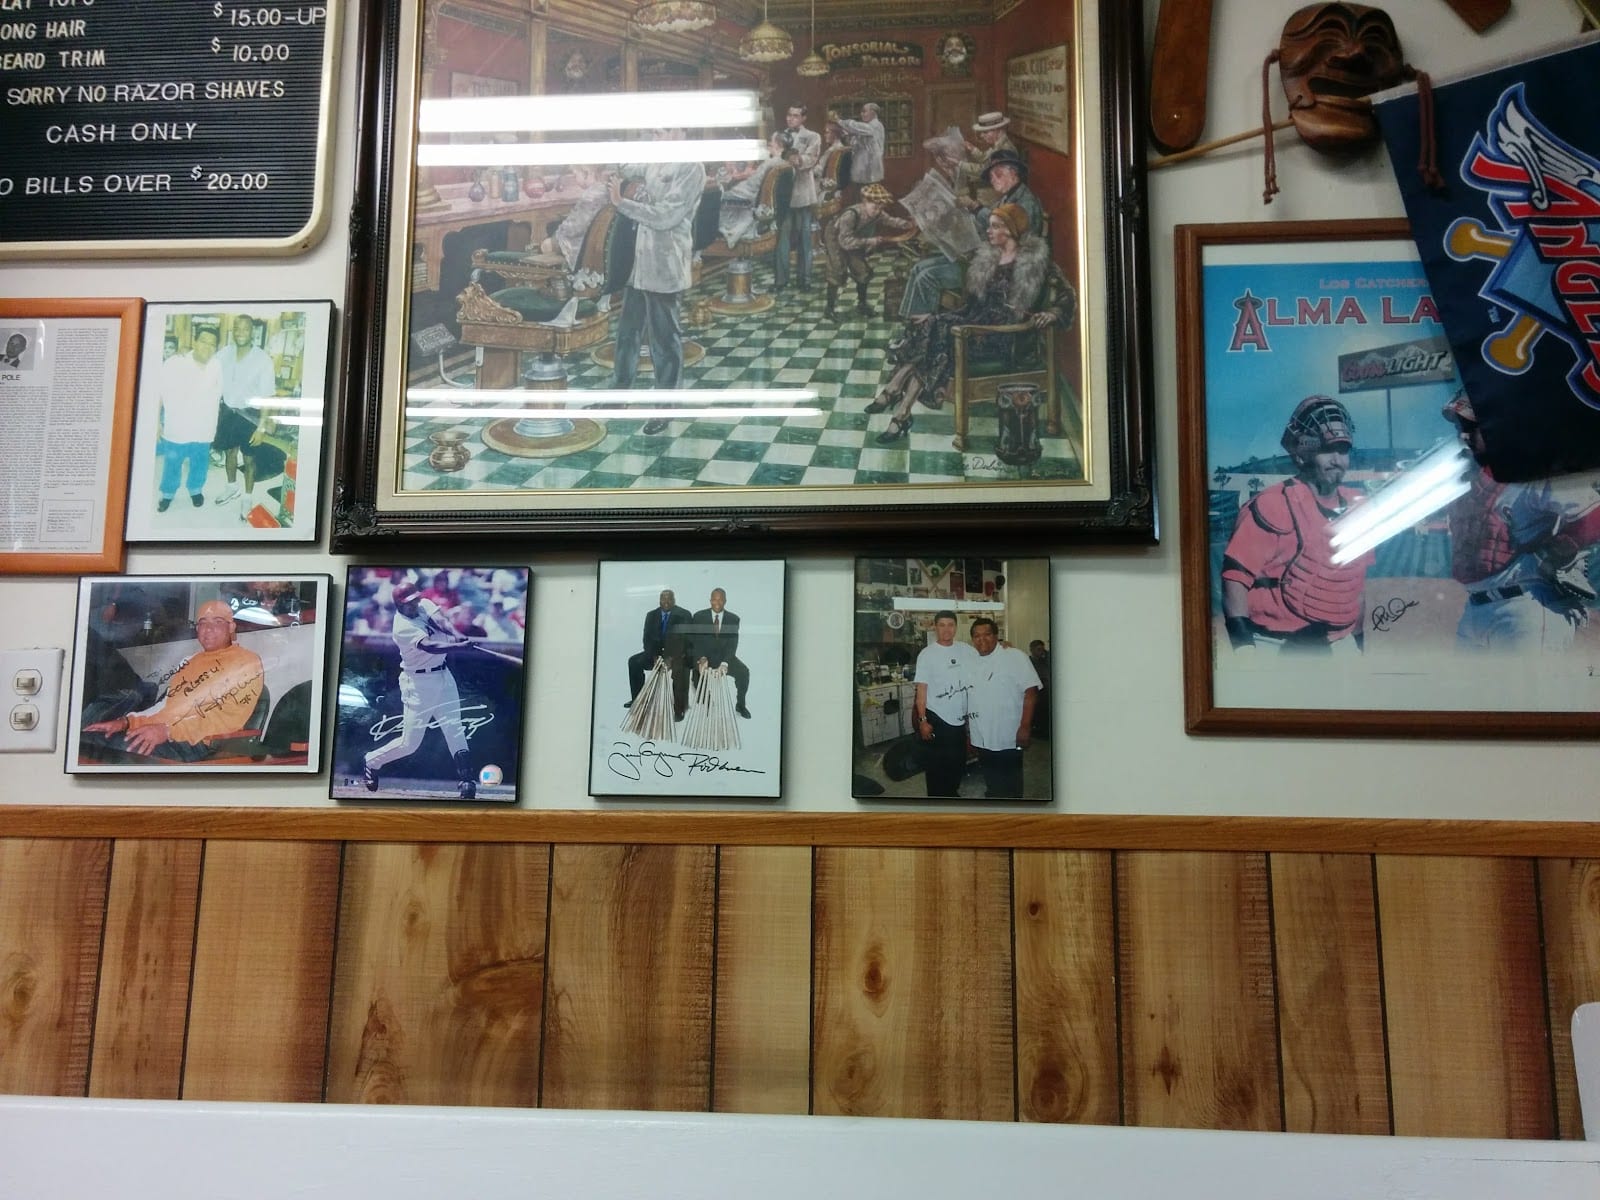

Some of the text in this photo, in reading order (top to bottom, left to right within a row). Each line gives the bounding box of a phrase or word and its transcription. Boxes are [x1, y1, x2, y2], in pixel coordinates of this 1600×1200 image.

[46, 19, 87, 38] HAIR
[59, 49, 106, 68] TRIM
[7, 80, 285, 105] SORRY NO RAZOR SHAVES
[46, 122, 197, 144] CASH ONLY
[25, 175, 93, 195] BILLS
[104, 174, 172, 193] OVER
[1355, 276, 1430, 289] CATCHER
[1228, 288, 1368, 352] ALMA
[1386, 351, 1446, 376] LIGHT
